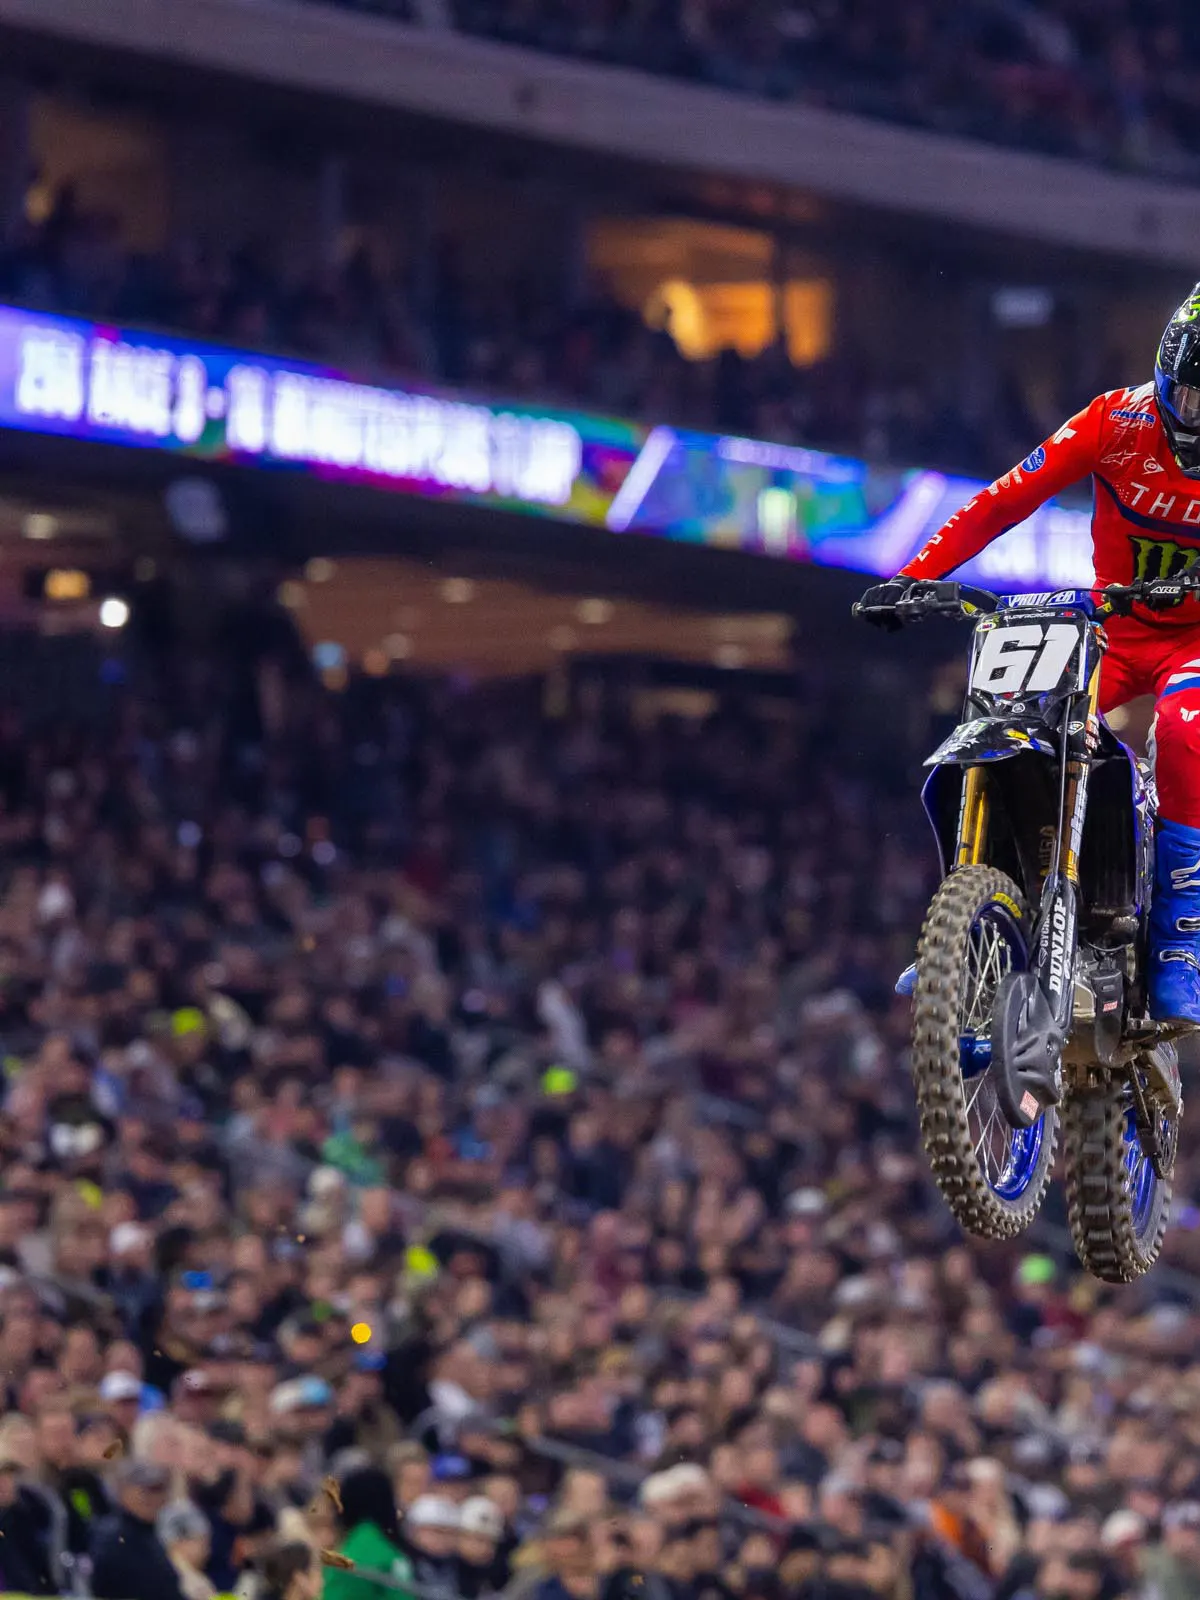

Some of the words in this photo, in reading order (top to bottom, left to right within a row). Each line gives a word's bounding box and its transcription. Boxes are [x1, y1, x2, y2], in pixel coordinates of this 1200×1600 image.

[1149, 585, 1181, 594] ARC
[972, 623, 1080, 695] 61
[1048, 896, 1068, 996] DUNLOP
